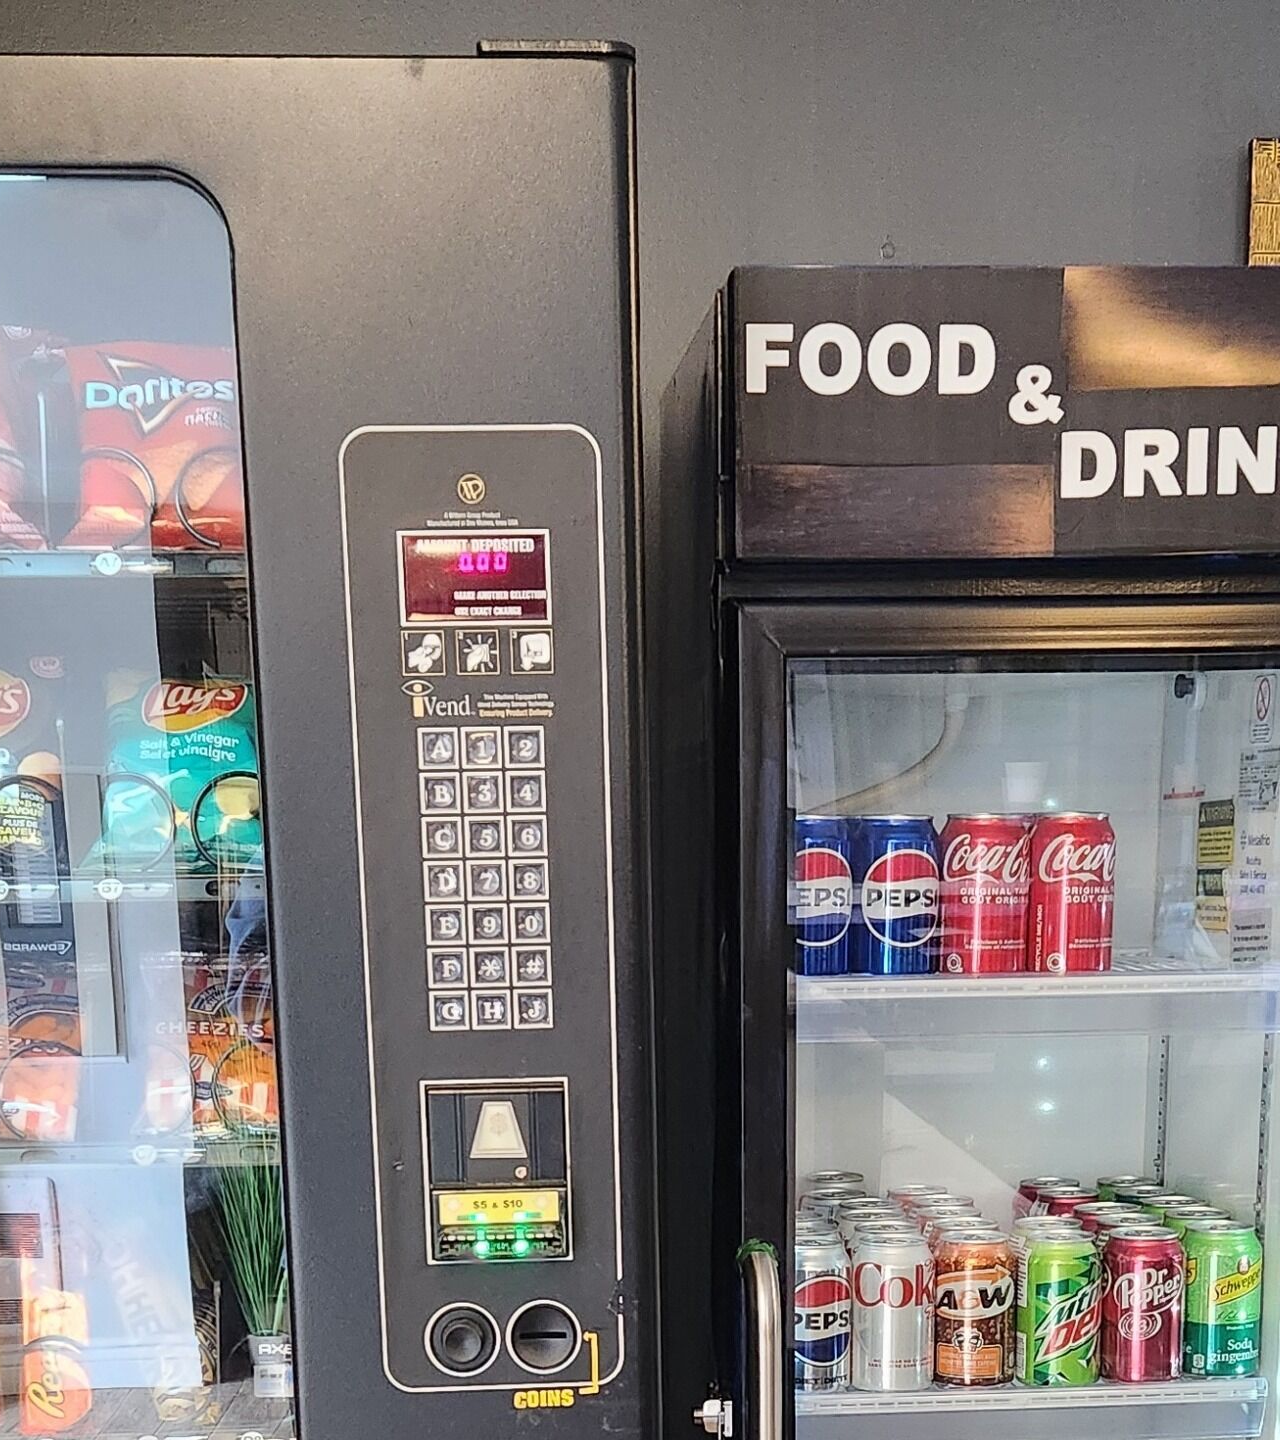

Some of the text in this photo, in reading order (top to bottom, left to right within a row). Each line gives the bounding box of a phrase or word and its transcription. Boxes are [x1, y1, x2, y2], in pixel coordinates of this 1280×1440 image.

[744, 321, 998, 397] FOOD
[85, 378, 235, 411] Doritos
[1007, 363, 1065, 426] &
[148, 681, 238, 718] Lay's
[139, 732, 240, 751] Salt & Vinegar
[431, 738, 450, 759] A
[476, 740, 488, 757] 1
[519, 739, 532, 757] 2
[139, 745, 237, 762] Sel et vinaigre
[435, 784, 451, 802] B
[478, 784, 492, 801] 3
[519, 783, 533, 801] 4
[480, 829, 493, 846] 5
[521, 828, 535, 845] 6
[438, 872, 456, 891] D
[482, 872, 495, 890] 7
[522, 872, 536, 890] 8
[959, 886, 1011, 896] ORIGINAL
[1065, 886, 1110, 896] ORIGINAL
[439, 916, 456, 935] E
[483, 916, 496, 934] 9
[524, 915, 538, 933] 0
[441, 960, 457, 978] F
[483, 1002, 503, 1020] H
[526, 1000, 540, 1018] J
[155, 1021, 265, 1039] CHEEZIES
[472, 1200, 488, 1210] $5
[503, 1199, 523, 1209] $10
[1142, 1267, 1169, 1291] Dr
[935, 1288, 1009, 1311] A&W
[1121, 1274, 1181, 1313] Pepper
[257, 1343, 292, 1356] AXE
[1227, 1337, 1253, 1352] Soda
[513, 1388, 575, 1410] COINS
